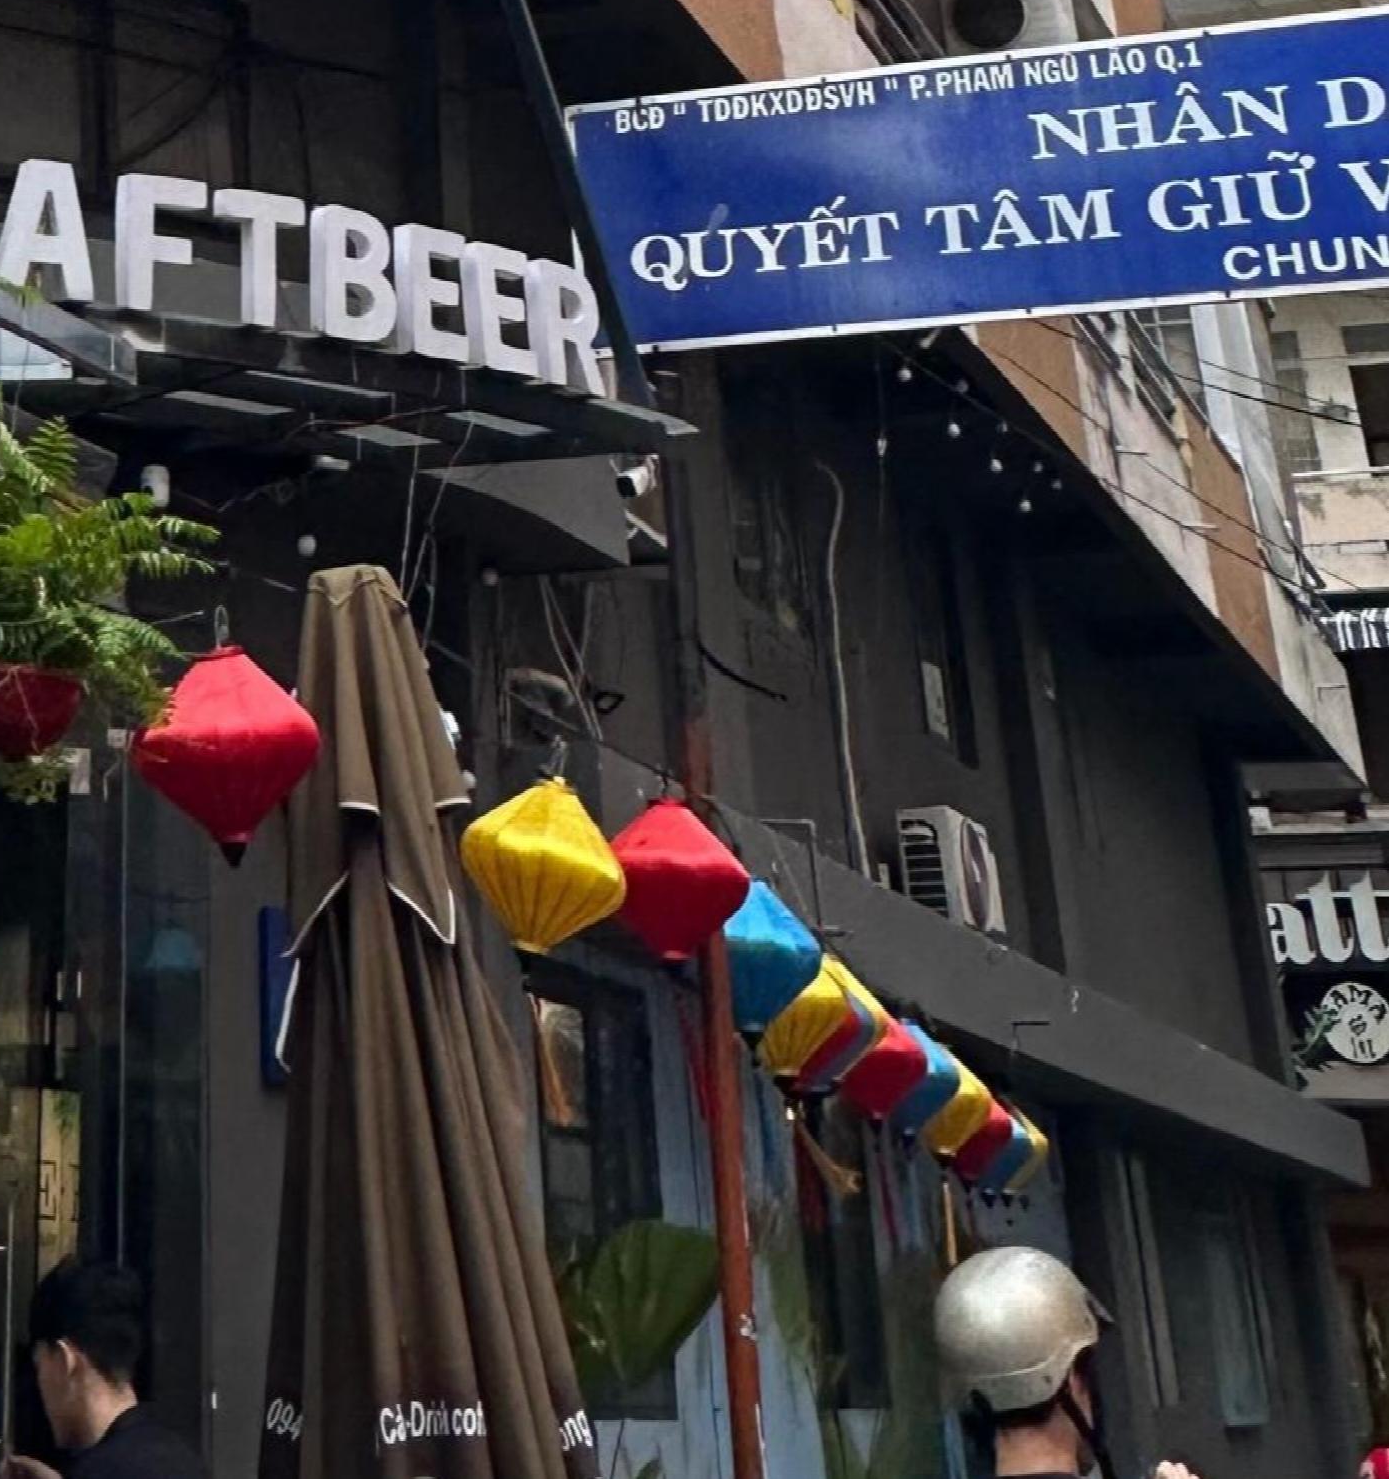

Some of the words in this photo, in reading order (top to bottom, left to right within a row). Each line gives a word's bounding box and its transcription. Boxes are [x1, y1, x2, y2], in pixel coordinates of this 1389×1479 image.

[1154, 41, 1203, 75] Q.1
[1026, 80, 1290, 161] NHÂN
[629, 194, 900, 291] QUYẾT
[924, 186, 1123, 255] TÂM
[1147, 150, 1317, 232] GIỮ
